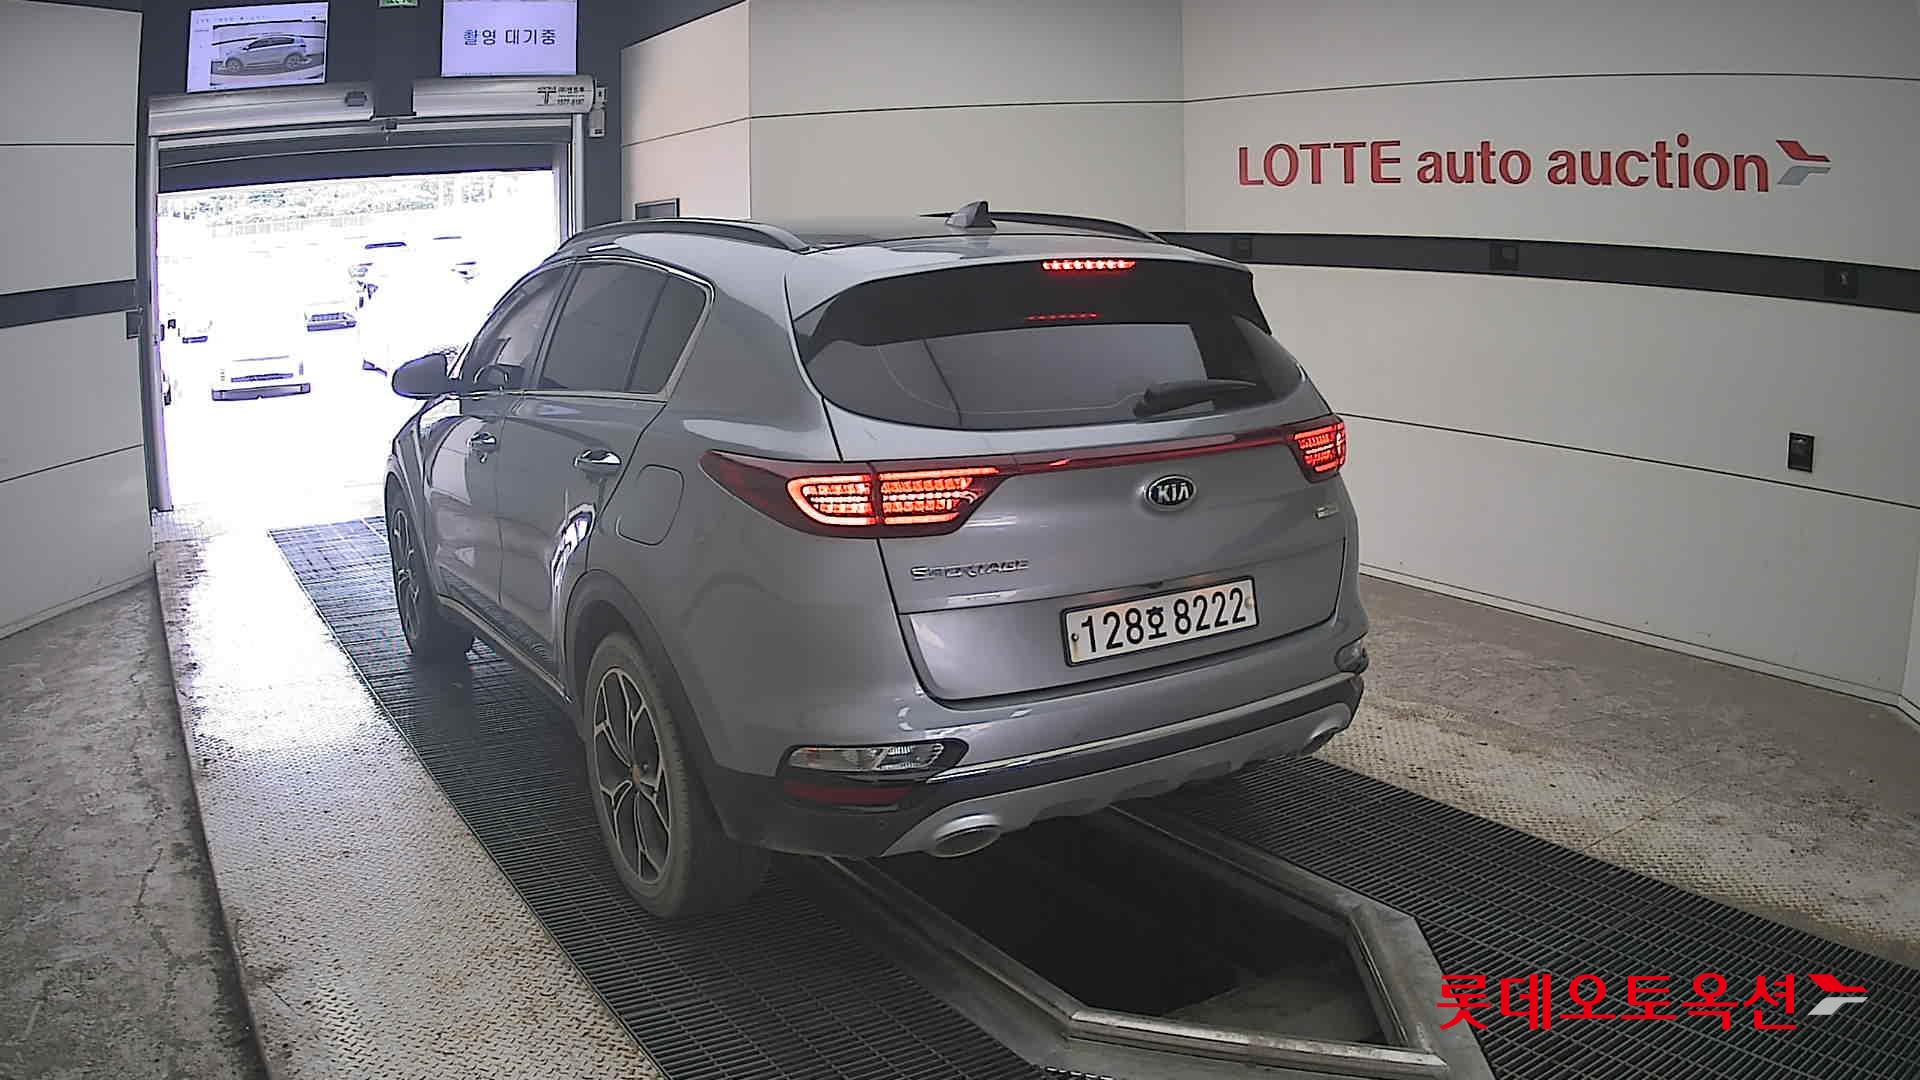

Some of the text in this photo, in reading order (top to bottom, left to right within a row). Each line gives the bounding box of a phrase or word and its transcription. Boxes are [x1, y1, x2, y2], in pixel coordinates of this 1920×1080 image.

[505, 29, 555, 45] 대기중
[1239, 133, 1769, 192] LOTTE auto auction
[1157, 483, 1189, 502] KIA
[1081, 588, 1246, 652] 128호 8222
